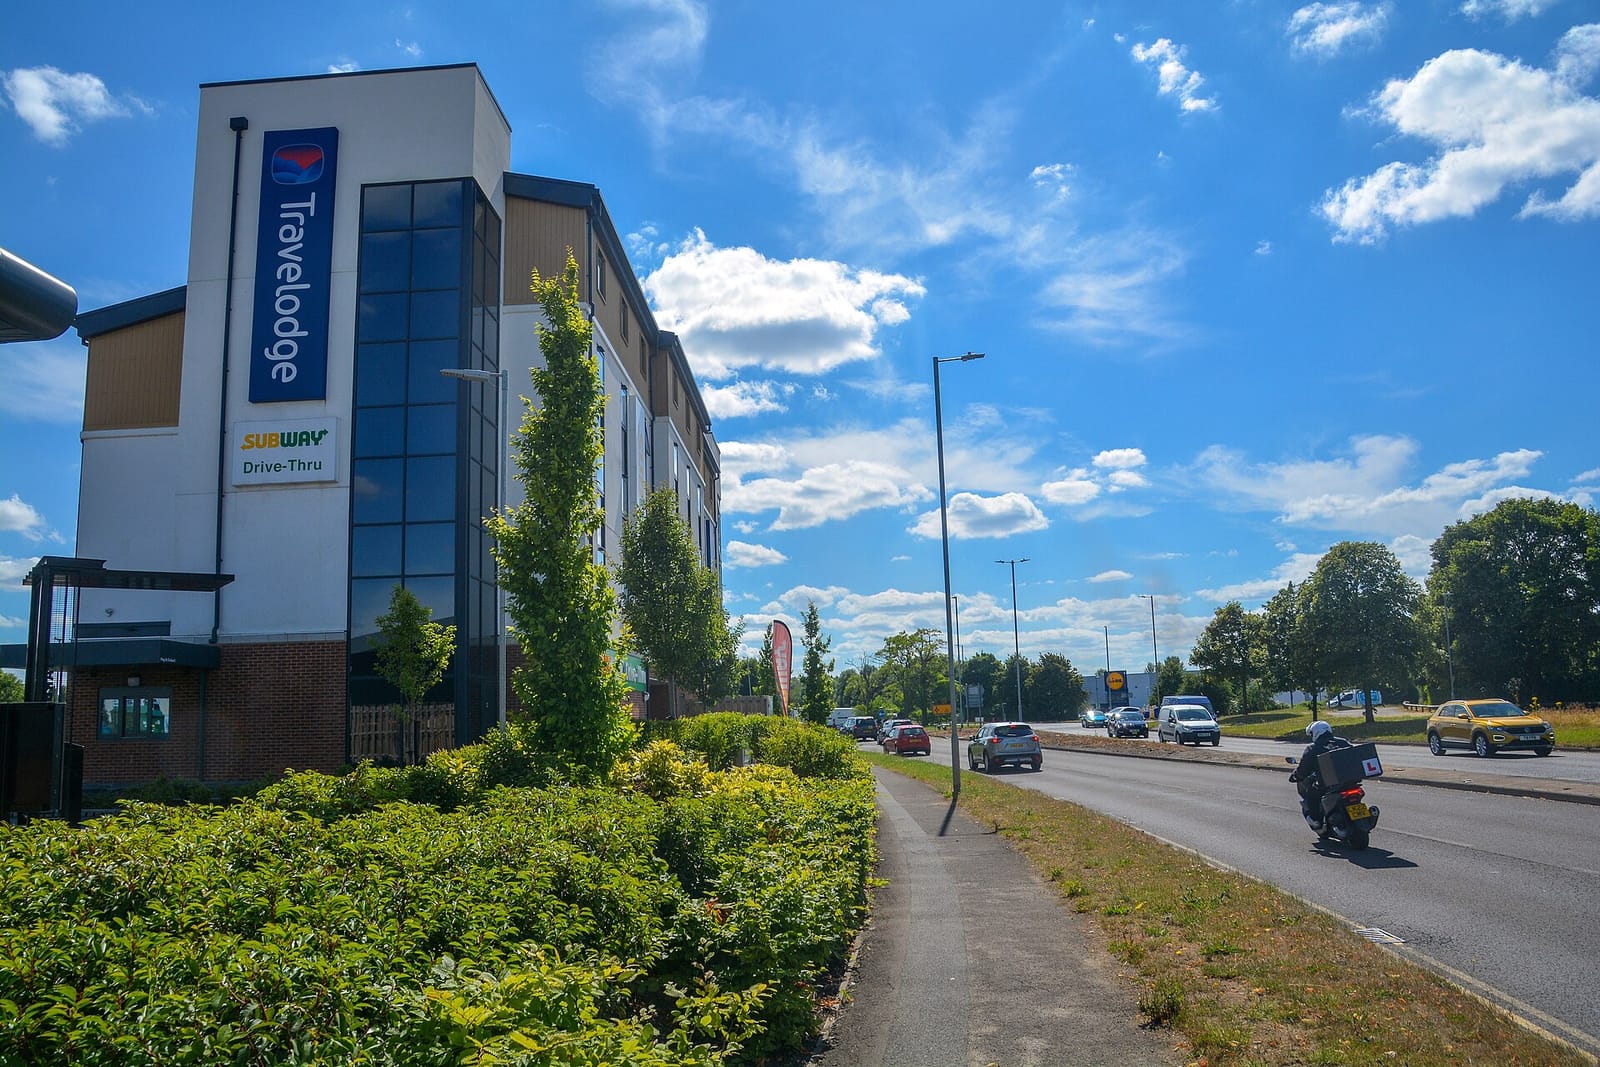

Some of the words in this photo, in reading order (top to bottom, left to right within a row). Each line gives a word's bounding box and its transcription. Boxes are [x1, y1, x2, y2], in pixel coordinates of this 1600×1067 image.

[264, 191, 316, 383] Travelodge
[240, 429, 328, 450] SUBWAY
[243, 459, 322, 474] Drive-Thru
[1367, 762, 1376, 771] L
